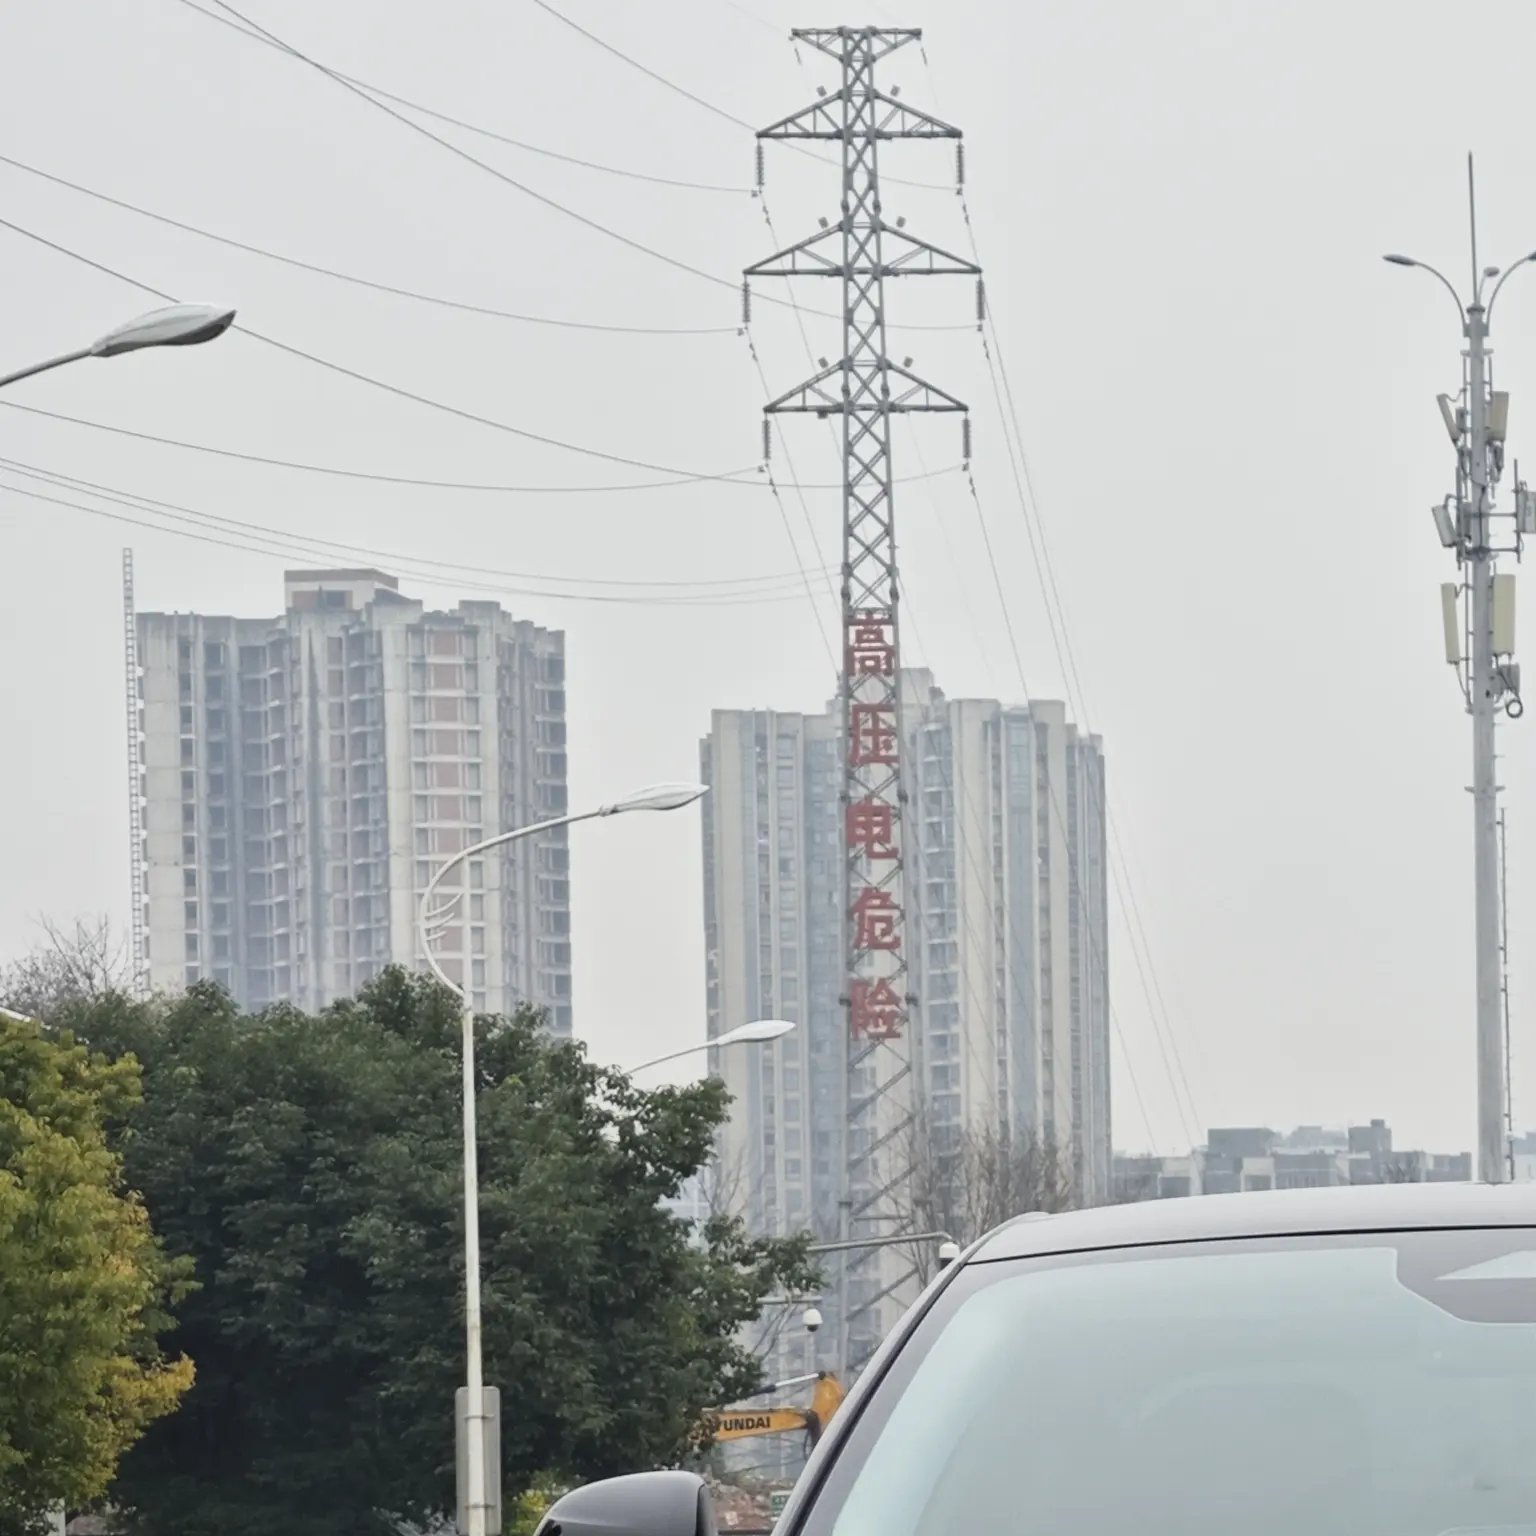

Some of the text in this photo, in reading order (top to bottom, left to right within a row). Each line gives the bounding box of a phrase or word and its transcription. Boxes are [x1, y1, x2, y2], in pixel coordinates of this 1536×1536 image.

[844, 611, 904, 1041] 高压电危险
